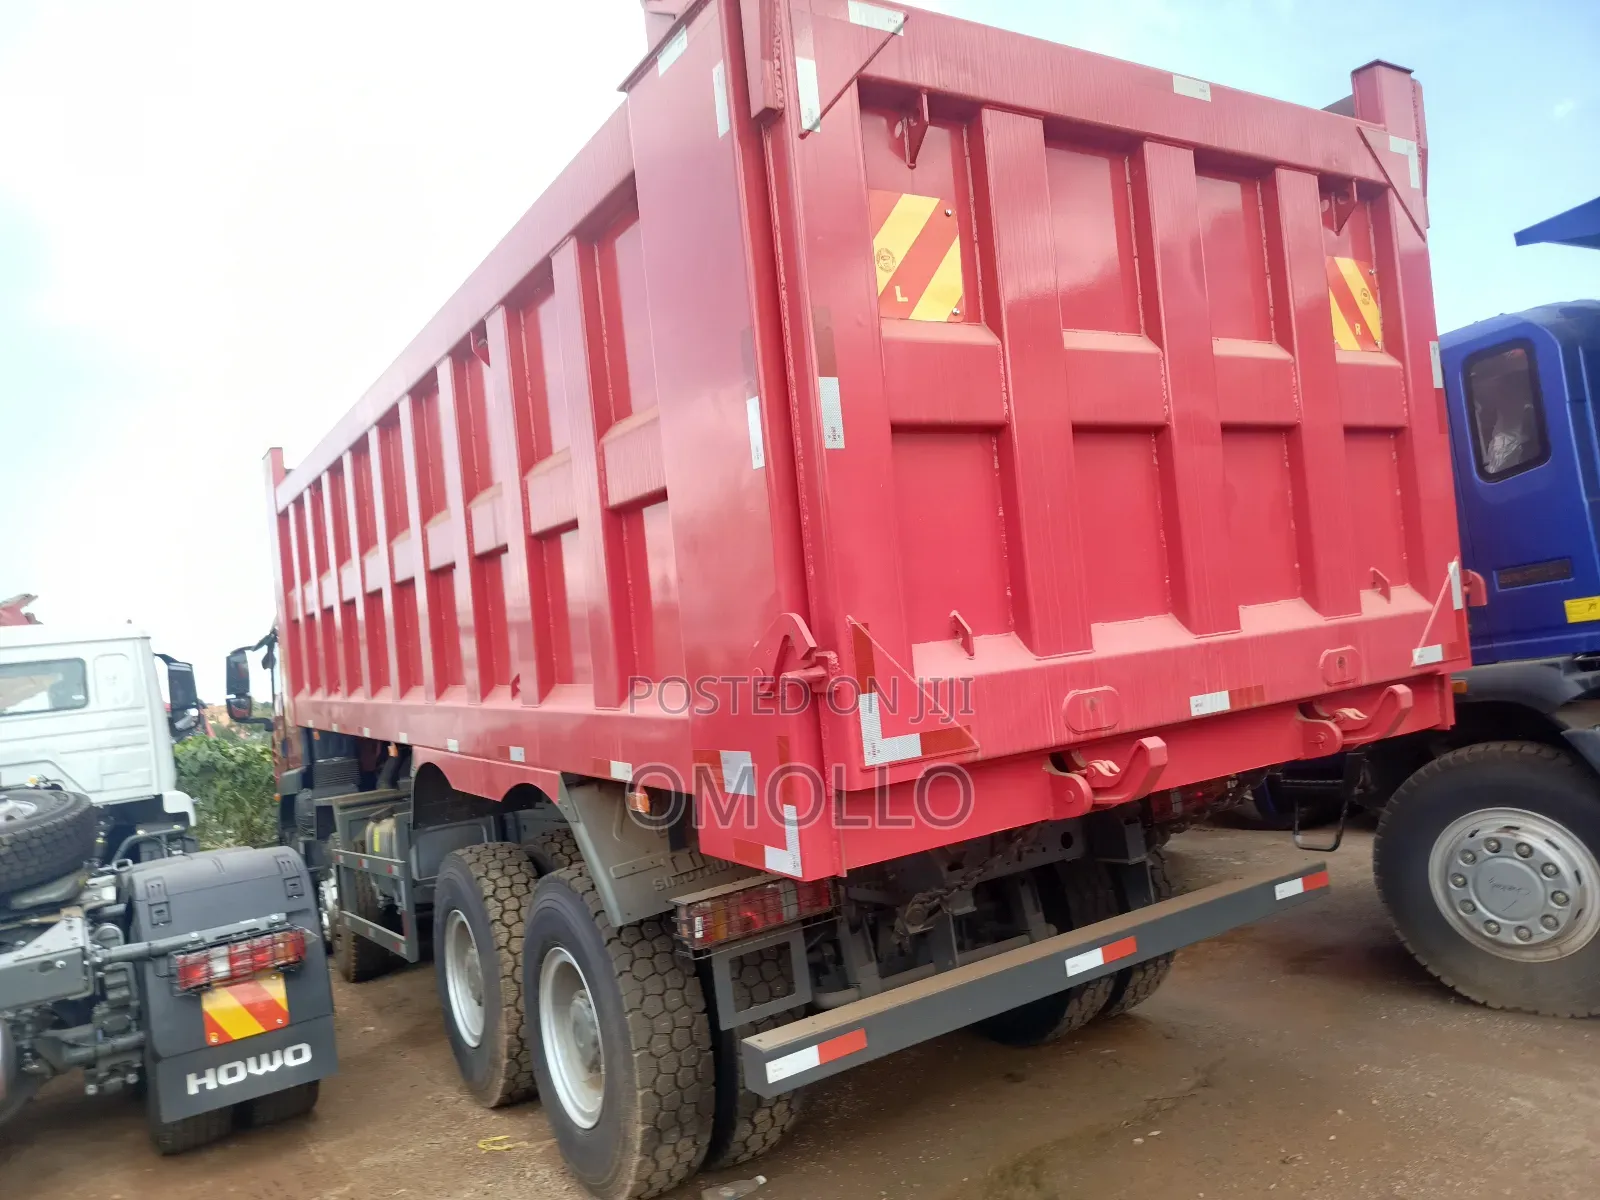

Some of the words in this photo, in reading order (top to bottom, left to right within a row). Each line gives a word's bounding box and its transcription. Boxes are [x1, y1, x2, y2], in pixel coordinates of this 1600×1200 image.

[894, 285, 909, 302] L
[1353, 322, 1362, 336] R
[186, 1042, 313, 1095] HOWO
